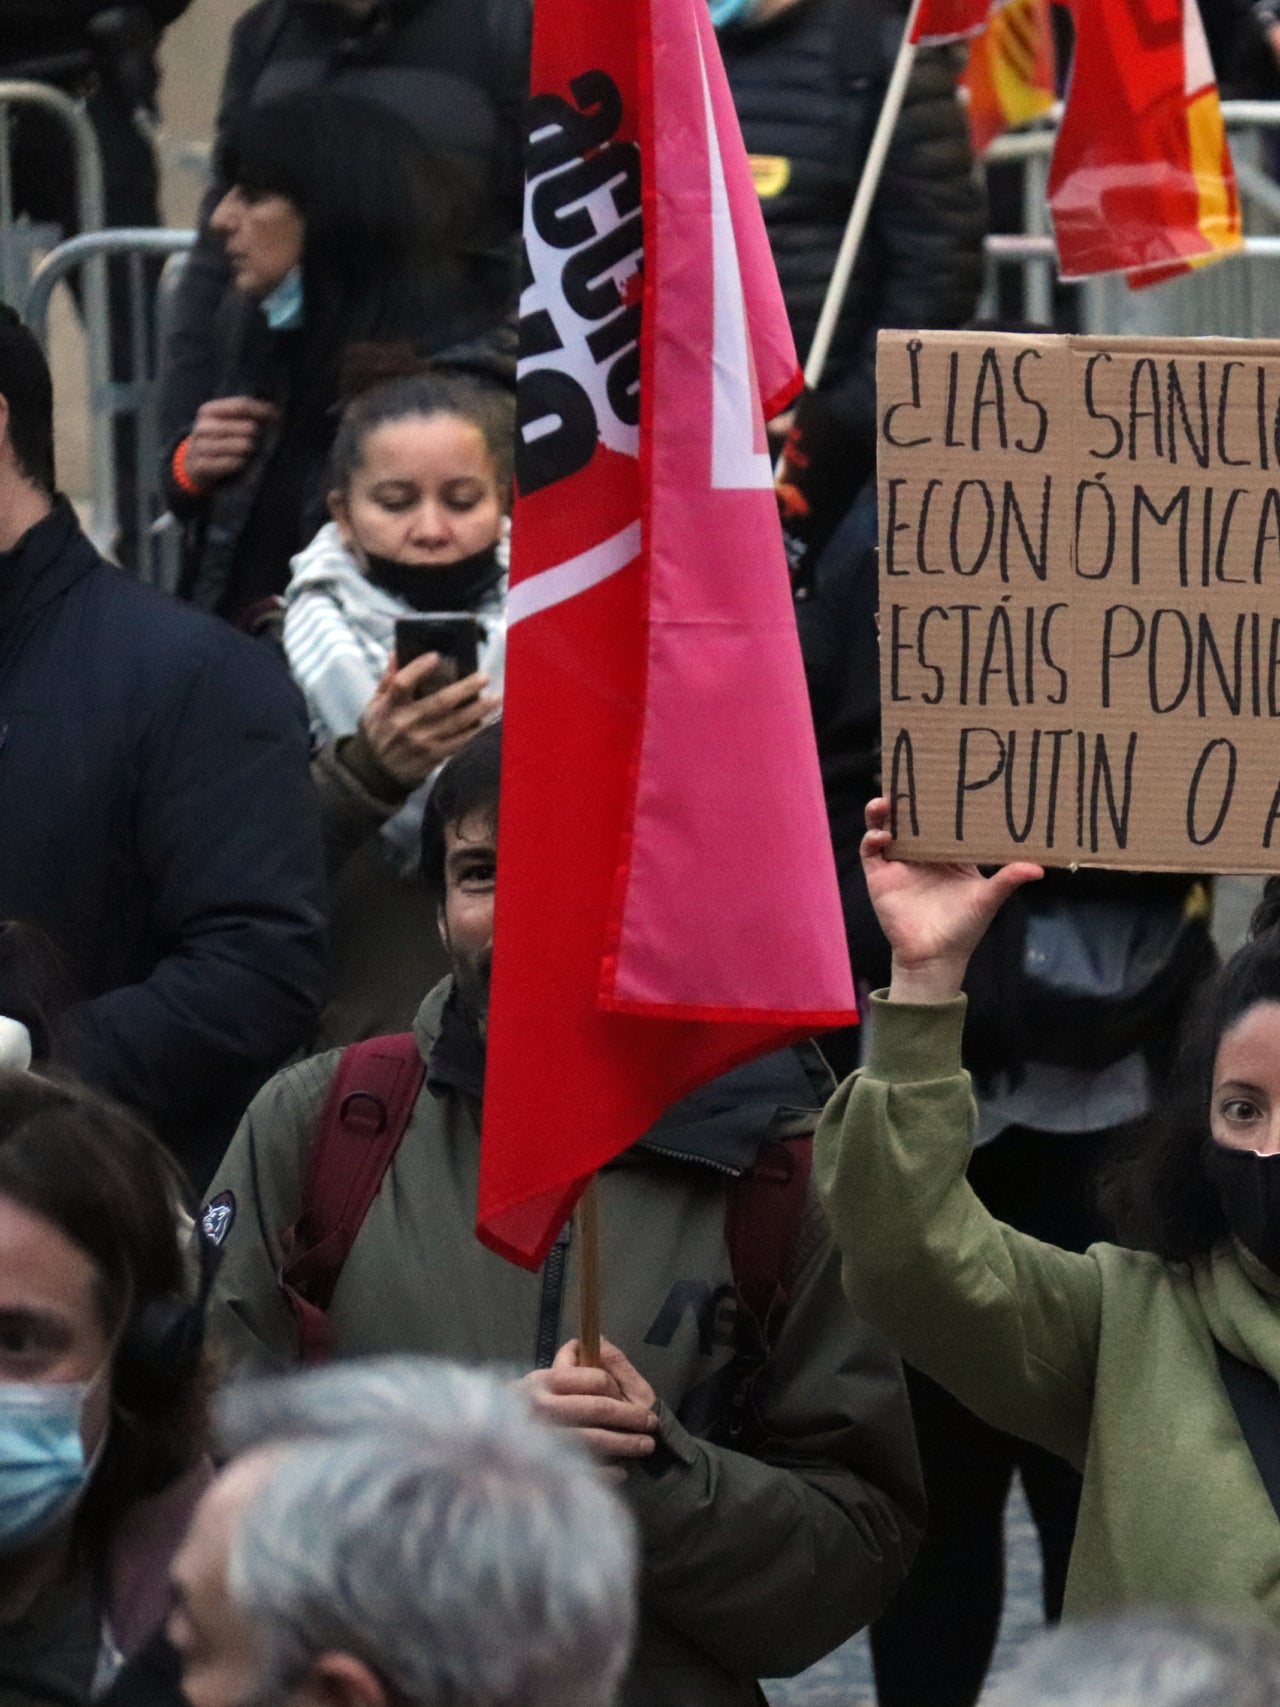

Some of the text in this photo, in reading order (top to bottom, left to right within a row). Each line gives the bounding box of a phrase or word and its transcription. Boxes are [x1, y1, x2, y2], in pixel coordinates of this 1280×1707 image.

[882, 339, 1048, 452] ¿LAS
[891, 595, 1070, 707] ESTÁIS
[890, 728, 920, 840] A
[955, 726, 1137, 852] PUTIN
[1186, 737, 1238, 846] O
